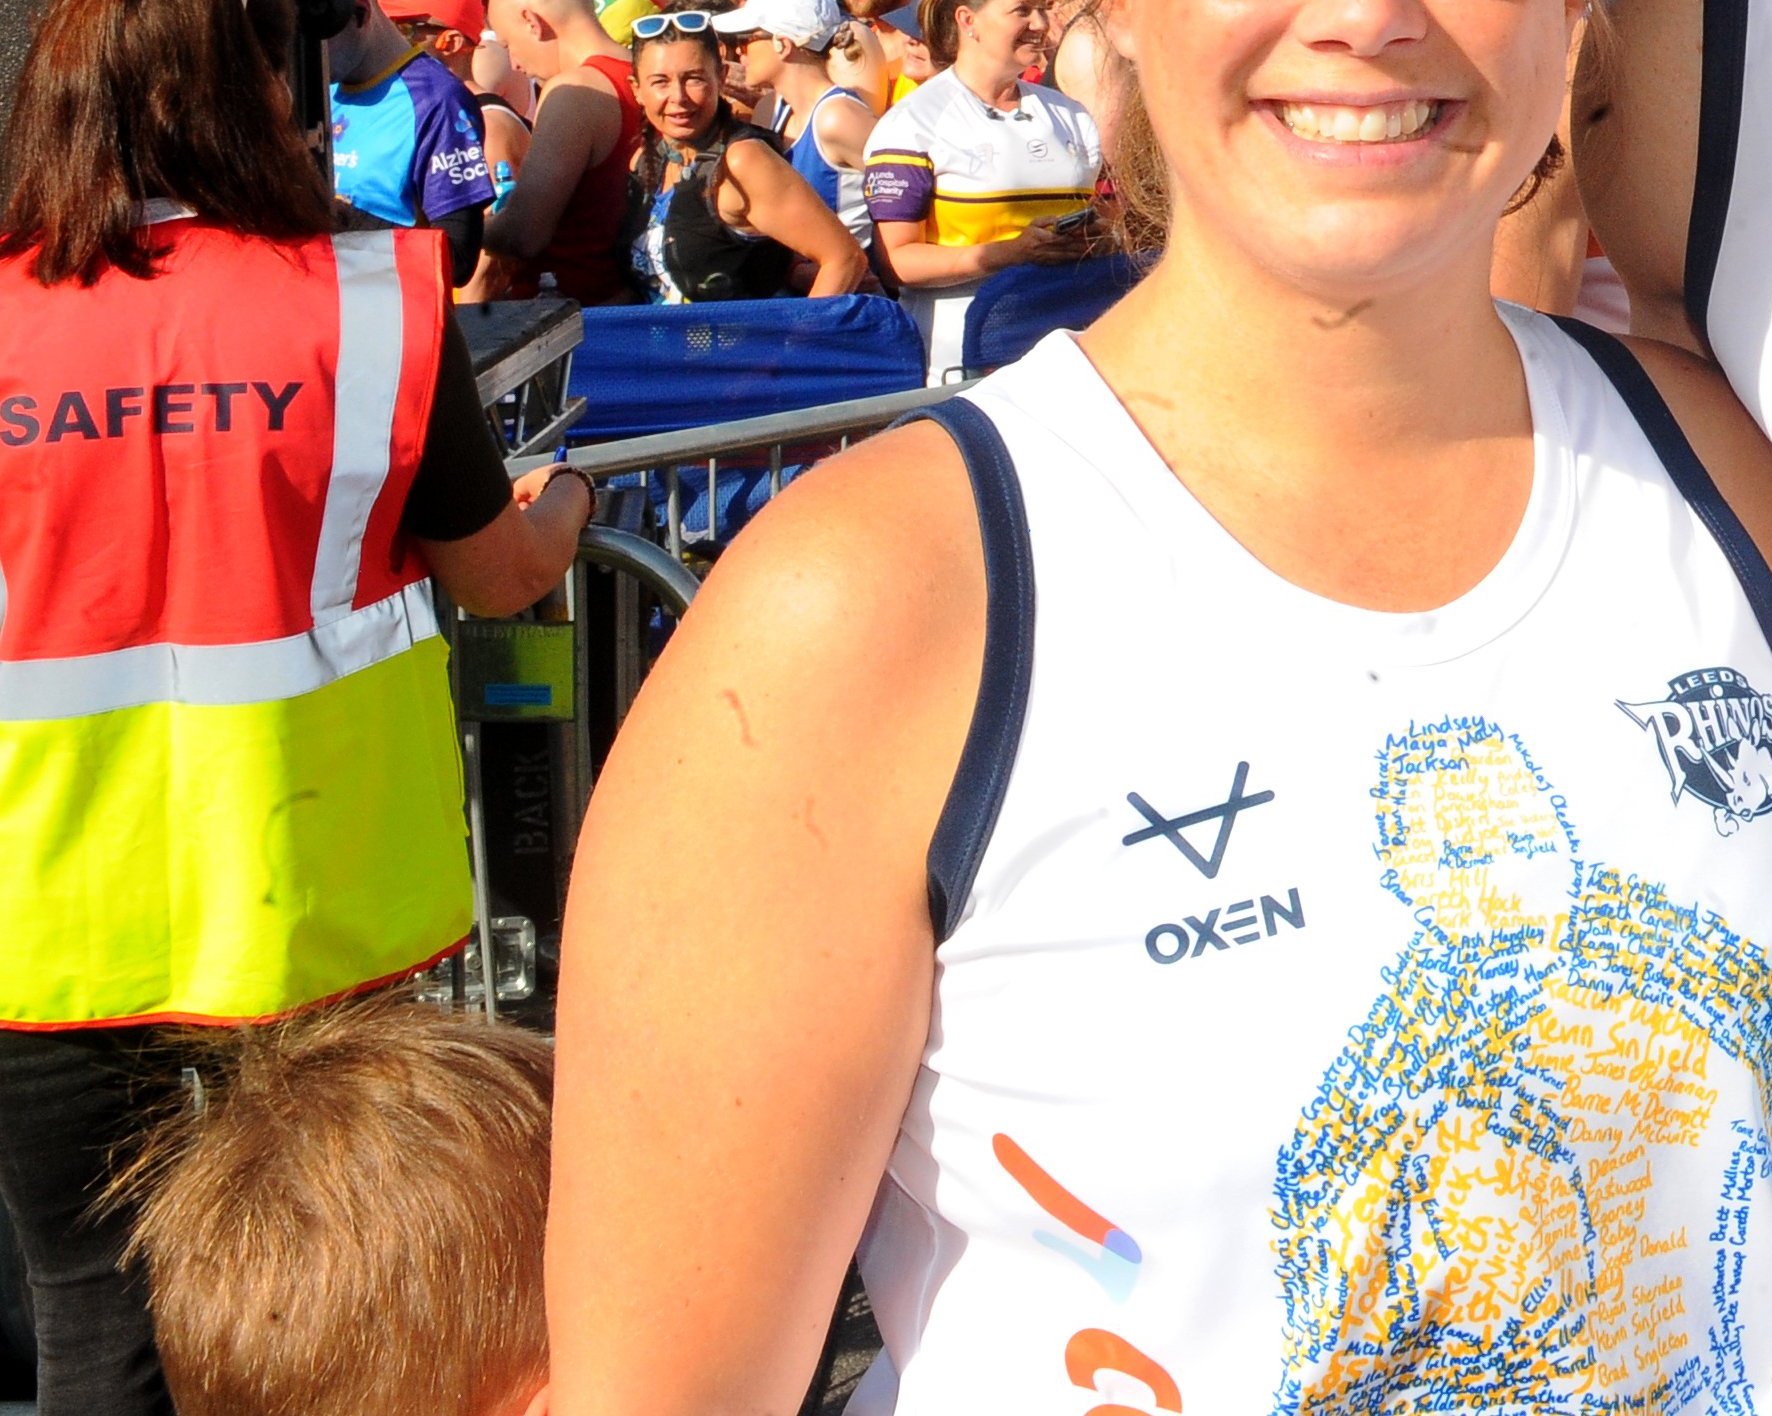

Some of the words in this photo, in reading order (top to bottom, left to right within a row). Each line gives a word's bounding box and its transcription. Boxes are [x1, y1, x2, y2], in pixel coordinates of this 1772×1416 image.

[0, 381, 304, 447] SAFETY
[1674, 669, 1748, 695] LEEDS
[1409, 714, 1486, 739] Lindsey
[1386, 733, 1447, 757] Maya
[1392, 752, 1470, 775] Jackson
[1145, 887, 1306, 964] OXEN
